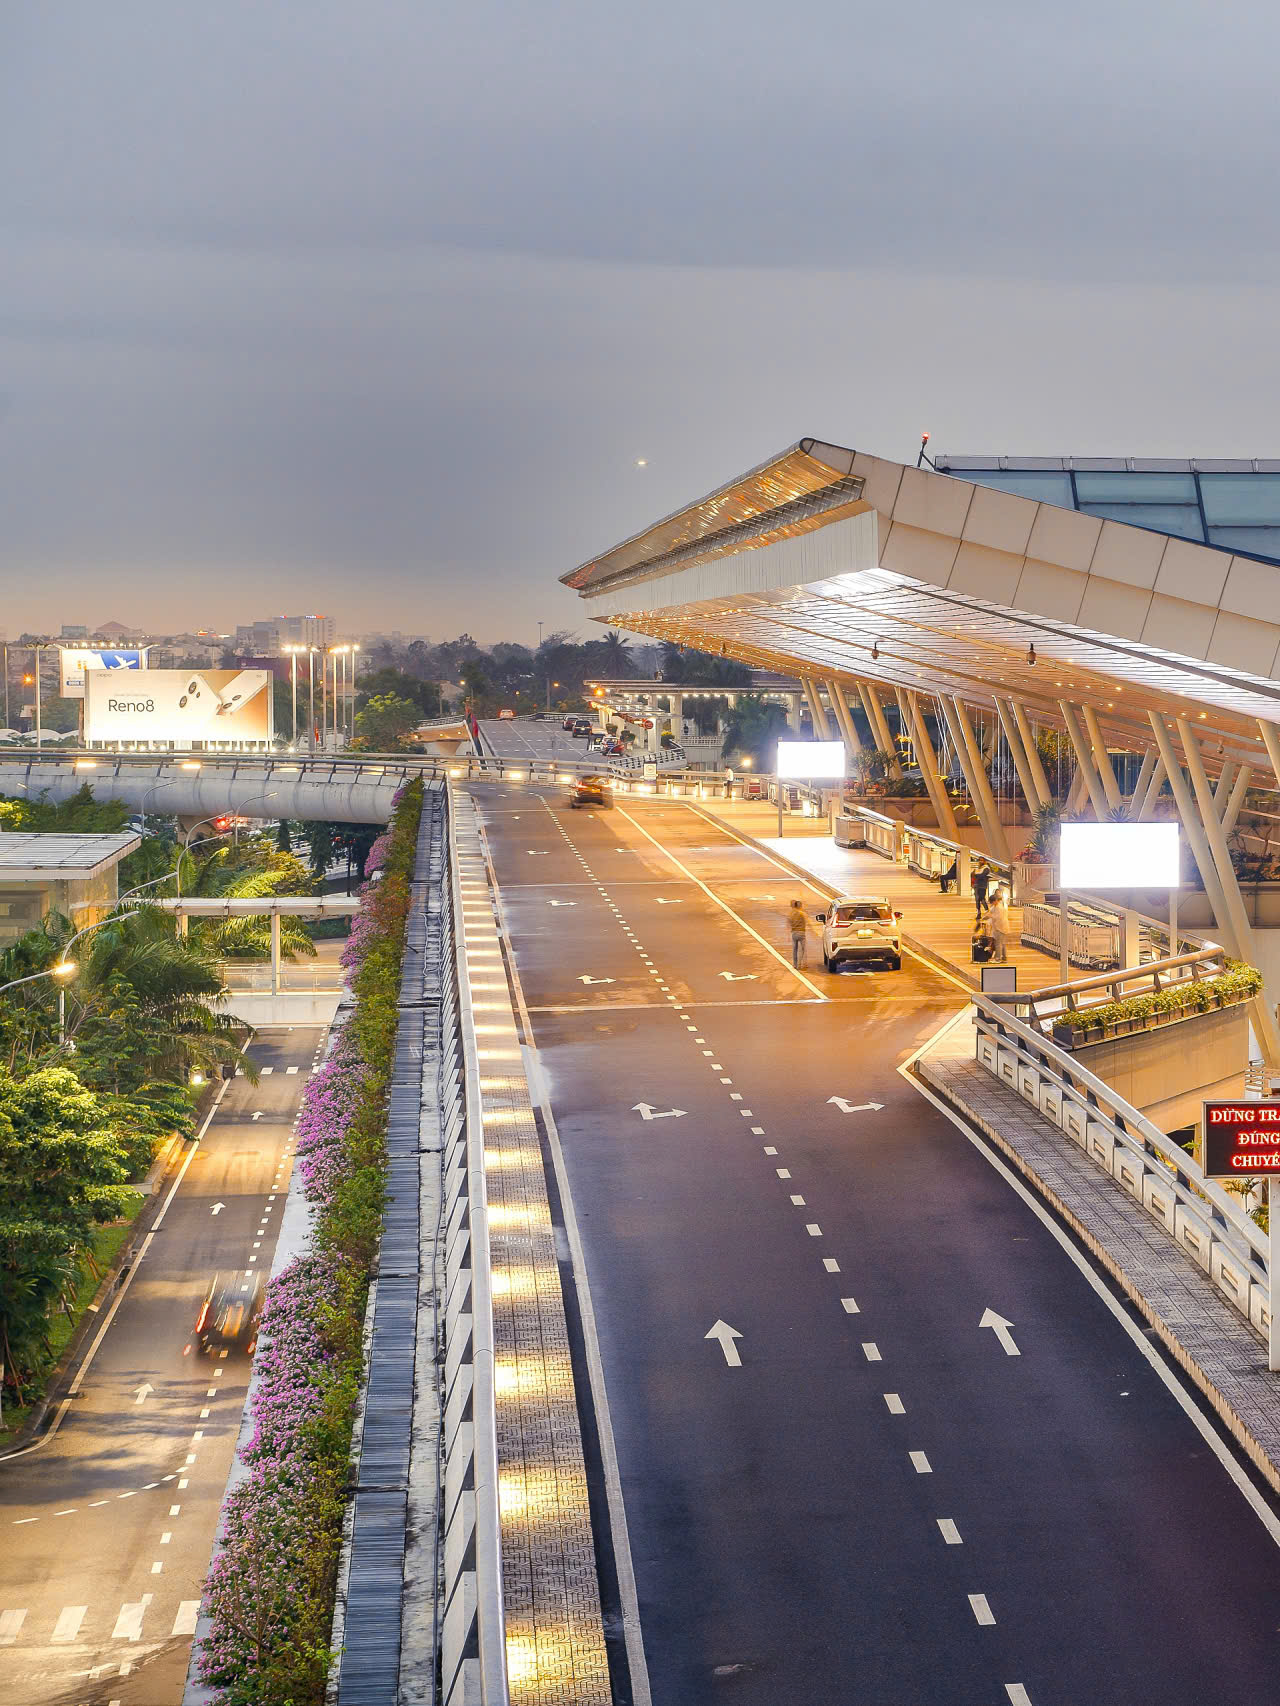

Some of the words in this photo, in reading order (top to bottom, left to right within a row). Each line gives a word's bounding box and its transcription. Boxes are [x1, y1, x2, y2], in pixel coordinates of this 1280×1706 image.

[108, 699, 155, 713] Reno8
[1210, 1107, 1255, 1122] DỪNG
[1238, 1130, 1280, 1145] ĐÚNG
